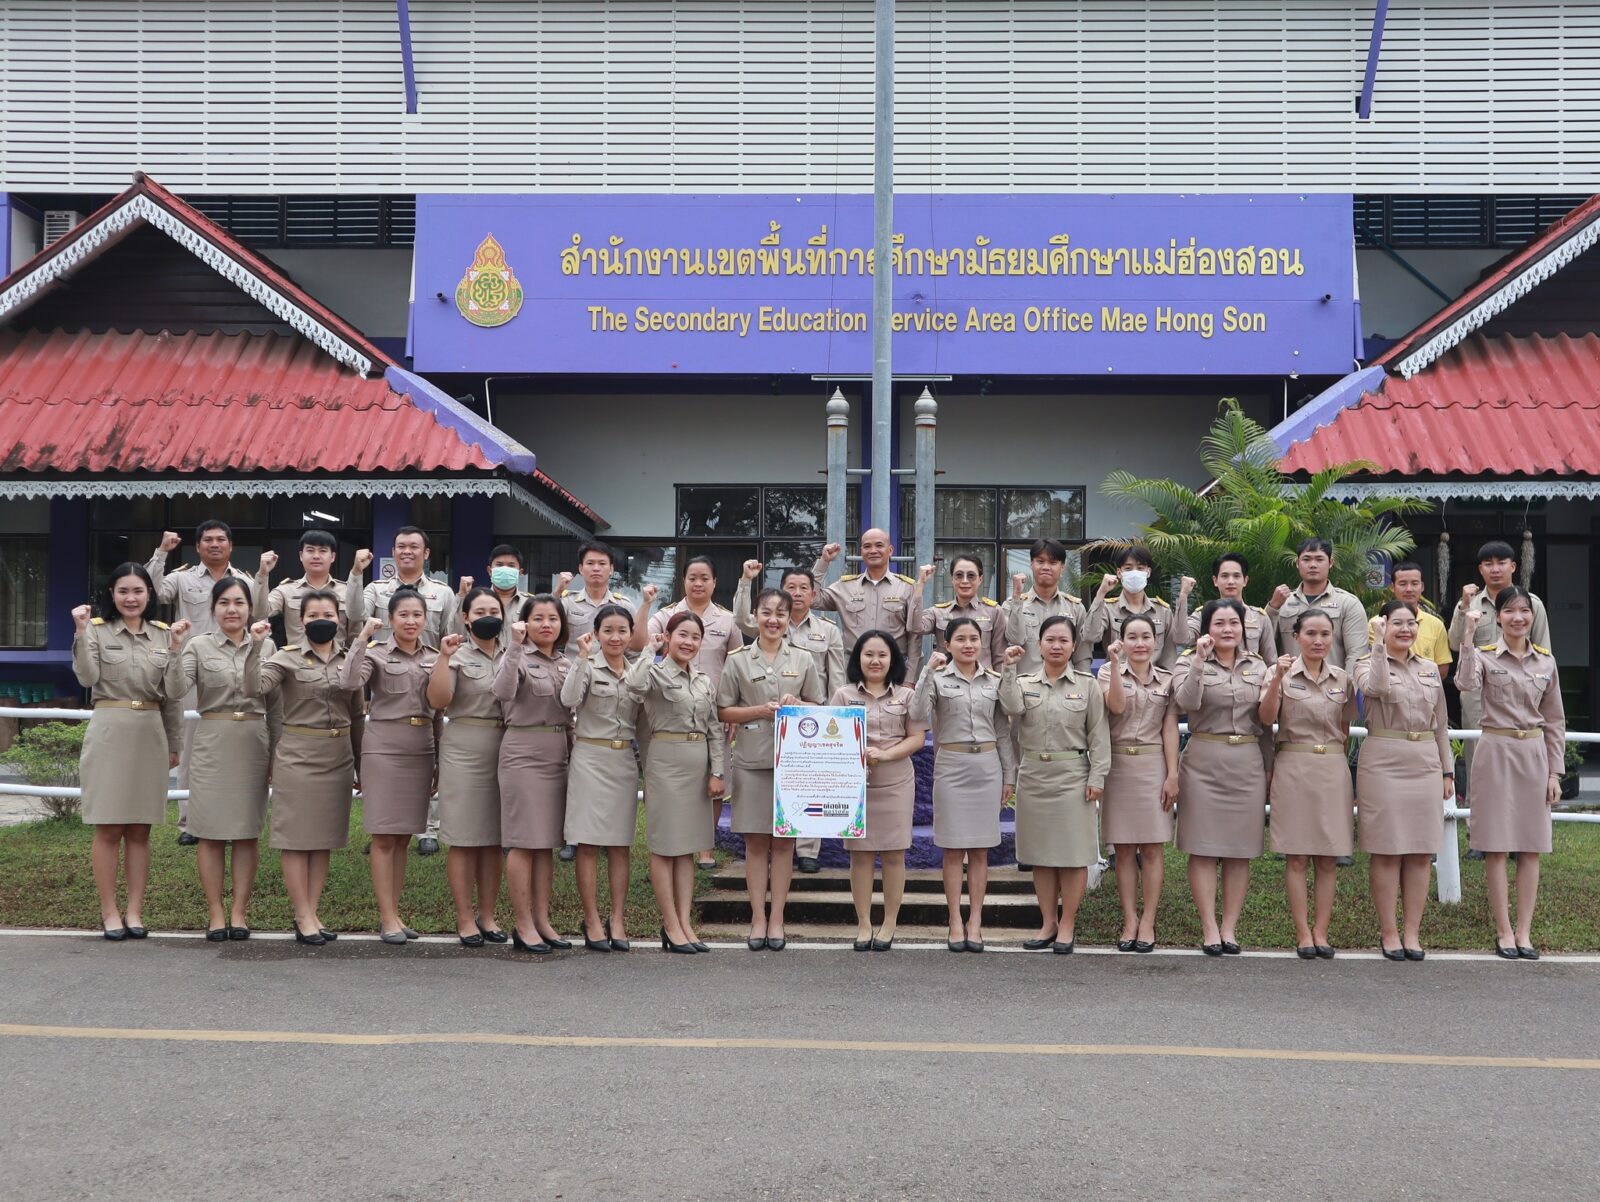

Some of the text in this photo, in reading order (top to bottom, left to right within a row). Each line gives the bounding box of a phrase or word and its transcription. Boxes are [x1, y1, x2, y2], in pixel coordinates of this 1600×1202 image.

[587, 305, 1266, 338] The Secondary Education ervice Area Office Mae Hong Son
